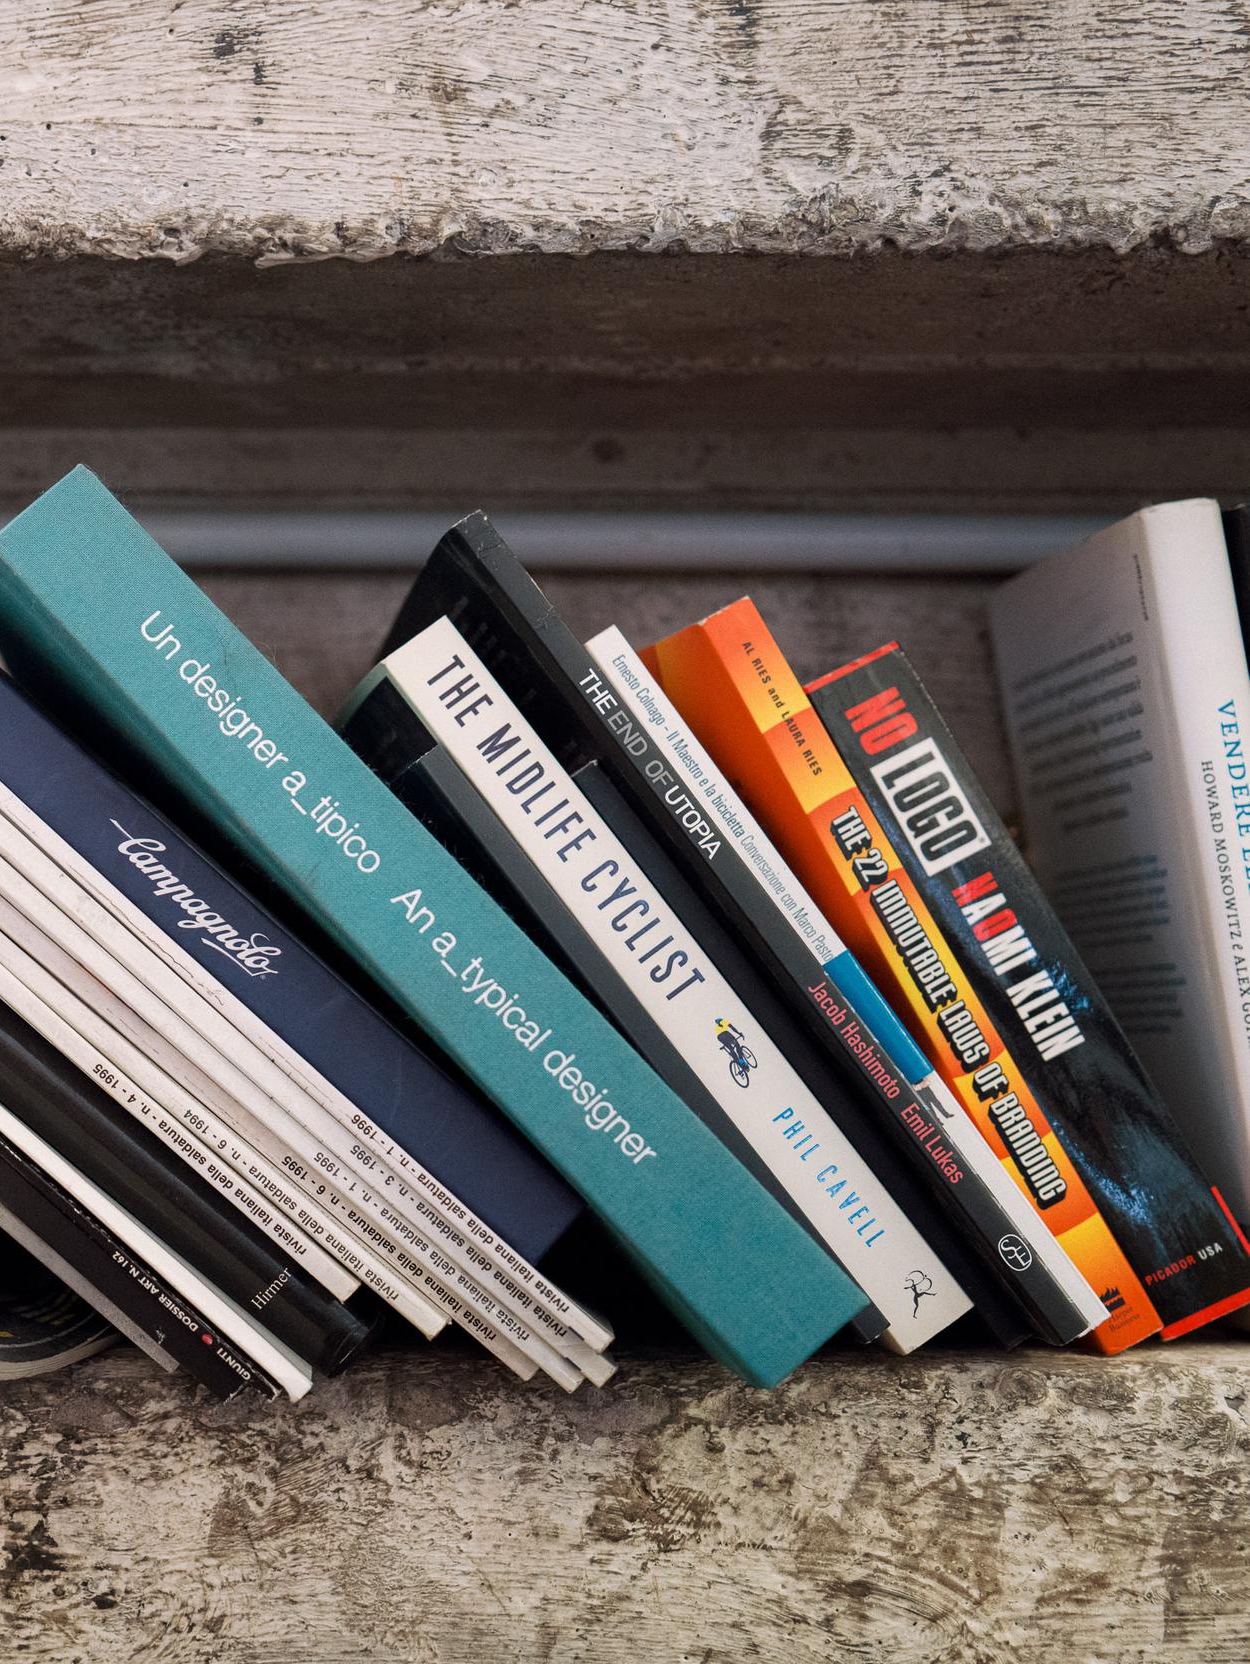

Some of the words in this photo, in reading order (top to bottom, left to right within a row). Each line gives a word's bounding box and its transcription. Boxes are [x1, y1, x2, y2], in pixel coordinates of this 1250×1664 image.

[611, 652, 641, 691] Ernesto
[634, 686, 666, 726] Colnago
[741, 640, 754, 655] AL
[750, 656, 772, 685] RIES
[766, 686, 785, 709] and
[780, 710, 806, 747] LAURA
[801, 748, 823, 776] RIES
[843, 684, 919, 758] NO
[139, 609, 182, 661] Un
[179, 659, 288, 768] designer
[281, 770, 380, 872] a_tipico
[665, 729, 680, 742] Il
[578, 666, 618, 715] THE
[606, 708, 648, 756] END
[643, 758, 675, 786] OF
[664, 784, 720, 859] UTOPIA
[670, 737, 704, 780] Maestro
[1216, 698, 1250, 837] VENDERE
[697, 777, 709, 788] e
[702, 782, 716, 798] la
[710, 792, 746, 839] bicicletta
[878, 747, 980, 865] LOGO
[426, 654, 493, 727] THE
[476, 722, 596, 862] MIDLIFE
[580, 859, 705, 1000] CYCLIST
[828, 803, 873, 850] THE
[740, 834, 786, 895] Conversazione
[850, 843, 892, 883] 22
[1200, 759, 1224, 834] HOWARD
[1212, 837, 1242, 940] MOSKOWITZ
[1232, 955, 1250, 998] ALEX
[109, 818, 281, 978] Campagnolo
[779, 892, 798, 912] con
[790, 906, 817, 939] Marco
[869, 876, 959, 1003] IMMUTABLE
[951, 871, 1036, 975] NAOMI
[1005, 969, 1085, 1060] KLEIN
[389, 888, 434, 933] An
[431, 931, 552, 1051] a_typical
[543, 1050, 656, 1163] designer
[936, 997, 993, 1063] LAWS
[91, 1062, 119, 1089] 1995
[807, 980, 847, 1026] Jacob
[840, 1021, 899, 1098] Hashimoto
[899, 1101, 936, 1141] Emil
[923, 1133, 964, 1184] Lukas
[969, 1057, 1012, 1092] OF
[125, 1092, 137, 1103] 4
[140, 1101, 151, 1116] n.
[182, 1108, 210, 1135] 1994
[349, 1113, 378, 1140] 1996
[158, 1119, 206, 1164] saldatura
[216, 1138, 228, 1150] 6
[230, 1146, 242, 1161] n.
[348, 1143, 377, 1170] 1995
[385, 1145, 395, 1156] 1
[987, 1089, 1069, 1200] BRANDING
[206, 1163, 234, 1189] della
[280, 1154, 309, 1181] 1995
[312, 1151, 340, 1177] 1995
[398, 1153, 410, 1168] n.
[772, 1107, 819, 1161] PHIL
[816, 1164, 884, 1247] CAVELL
[248, 1165, 297, 1210] saldatura
[315, 1183, 327, 1195] 6
[347, 1181, 357, 1192] 1
[361, 1188, 372, 1203] n.
[383, 1174, 395, 1186] 3
[397, 1182, 409, 1197] n.
[416, 1173, 466, 1219] saldatura
[233, 1187, 273, 1227] italiana
[329, 1191, 340, 1206] n.
[272, 1222, 307, 1255] rivista
[296, 1208, 325, 1235] della
[347, 1209, 396, 1253] saldatura
[380, 1207, 428, 1251] saldatura
[415, 1201, 465, 1247] saldatura
[465, 1217, 494, 1245] della
[111, 1249, 129, 1268] 162
[324, 1232, 364, 1273] italiana
[396, 1251, 424, 1277] della
[428, 1249, 456, 1276] della
[464, 1244, 493, 1272] della
[493, 1242, 535, 1284] italiana
[1144, 1255, 1195, 1285] PICADOR
[1196, 1241, 1223, 1260] USA
[127, 1263, 140, 1278] N.
[136, 1275, 160, 1295] ART
[249, 1266, 292, 1310] Hirmer
[363, 1268, 399, 1301] rivista
[423, 1274, 463, 1314] italiana
[456, 1273, 496, 1313] italiana
[492, 1269, 534, 1309] italiana
[533, 1279, 570, 1313] rivista
[157, 1292, 199, 1332] DOSSIER
[461, 1308, 497, 1341] rivista
[495, 1308, 530, 1341] rivista
[531, 1303, 568, 1338] rivista
[215, 1346, 251, 1381] GIUNTI
